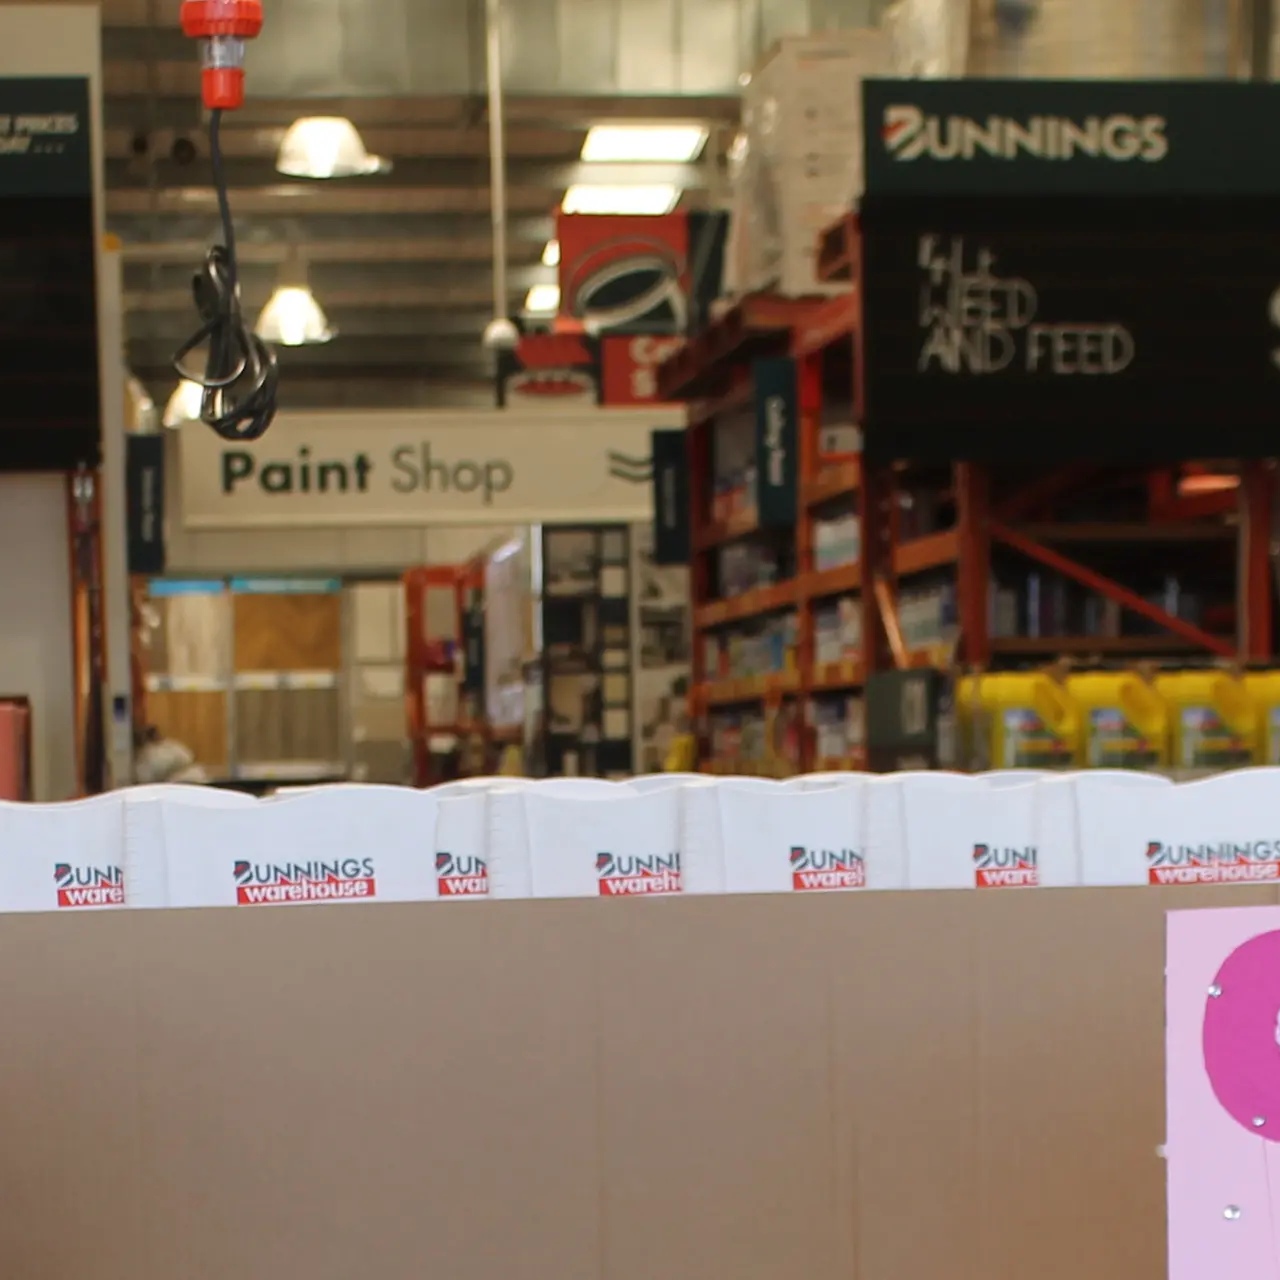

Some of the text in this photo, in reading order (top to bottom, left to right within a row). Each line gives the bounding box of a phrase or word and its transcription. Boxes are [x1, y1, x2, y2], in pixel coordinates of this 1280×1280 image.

[880, 104, 1168, 162] BUNNINGS
[918, 322, 1135, 374] AND FEED
[222, 441, 515, 506] Paint Shop
[233, 857, 375, 885] BUNNINGS
[596, 852, 681, 876] BUNNI
[1156, 857, 1279, 884] warehouse
[244, 879, 369, 904] warehouse
